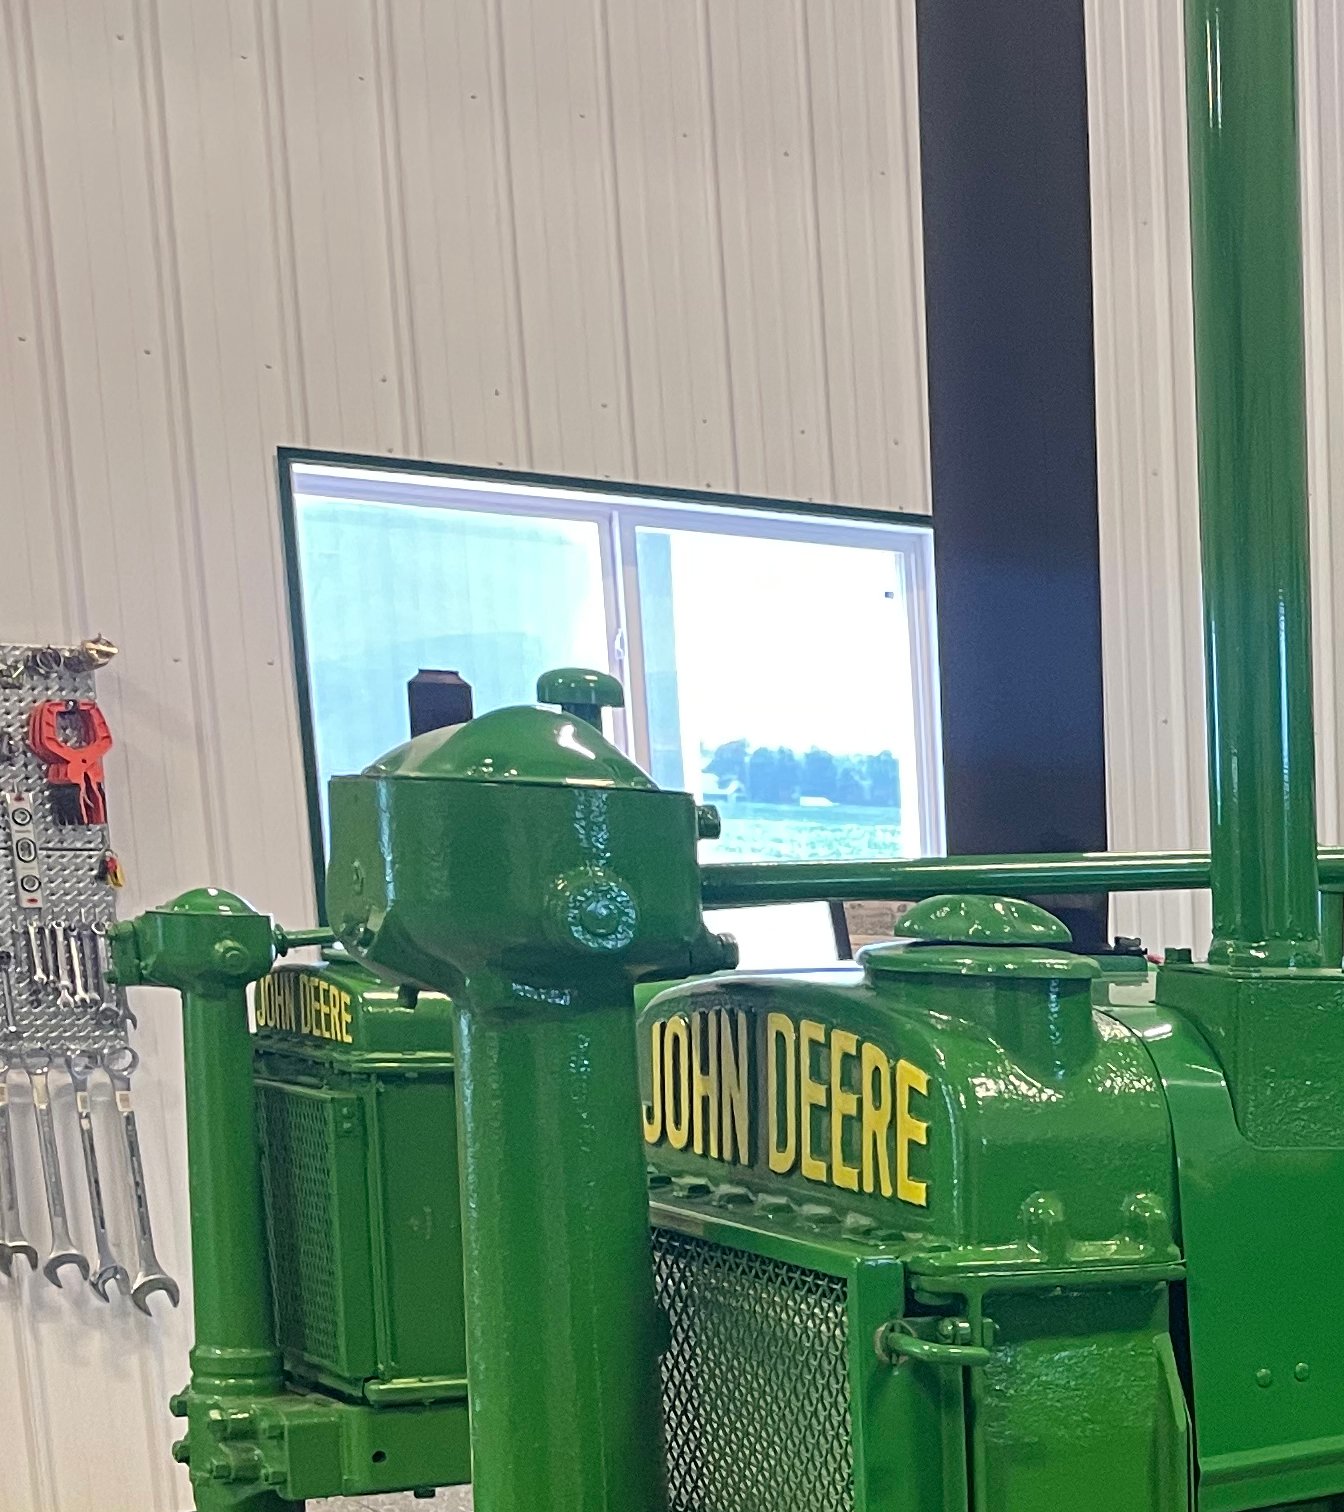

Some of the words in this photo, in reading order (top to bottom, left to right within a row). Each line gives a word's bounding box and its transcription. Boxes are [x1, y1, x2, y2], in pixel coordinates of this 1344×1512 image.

[256, 972, 296, 1033] JOHN
[299, 973, 353, 1044] DEERE
[642, 1006, 750, 1166] JOHN
[767, 1012, 931, 1207] DEERE
